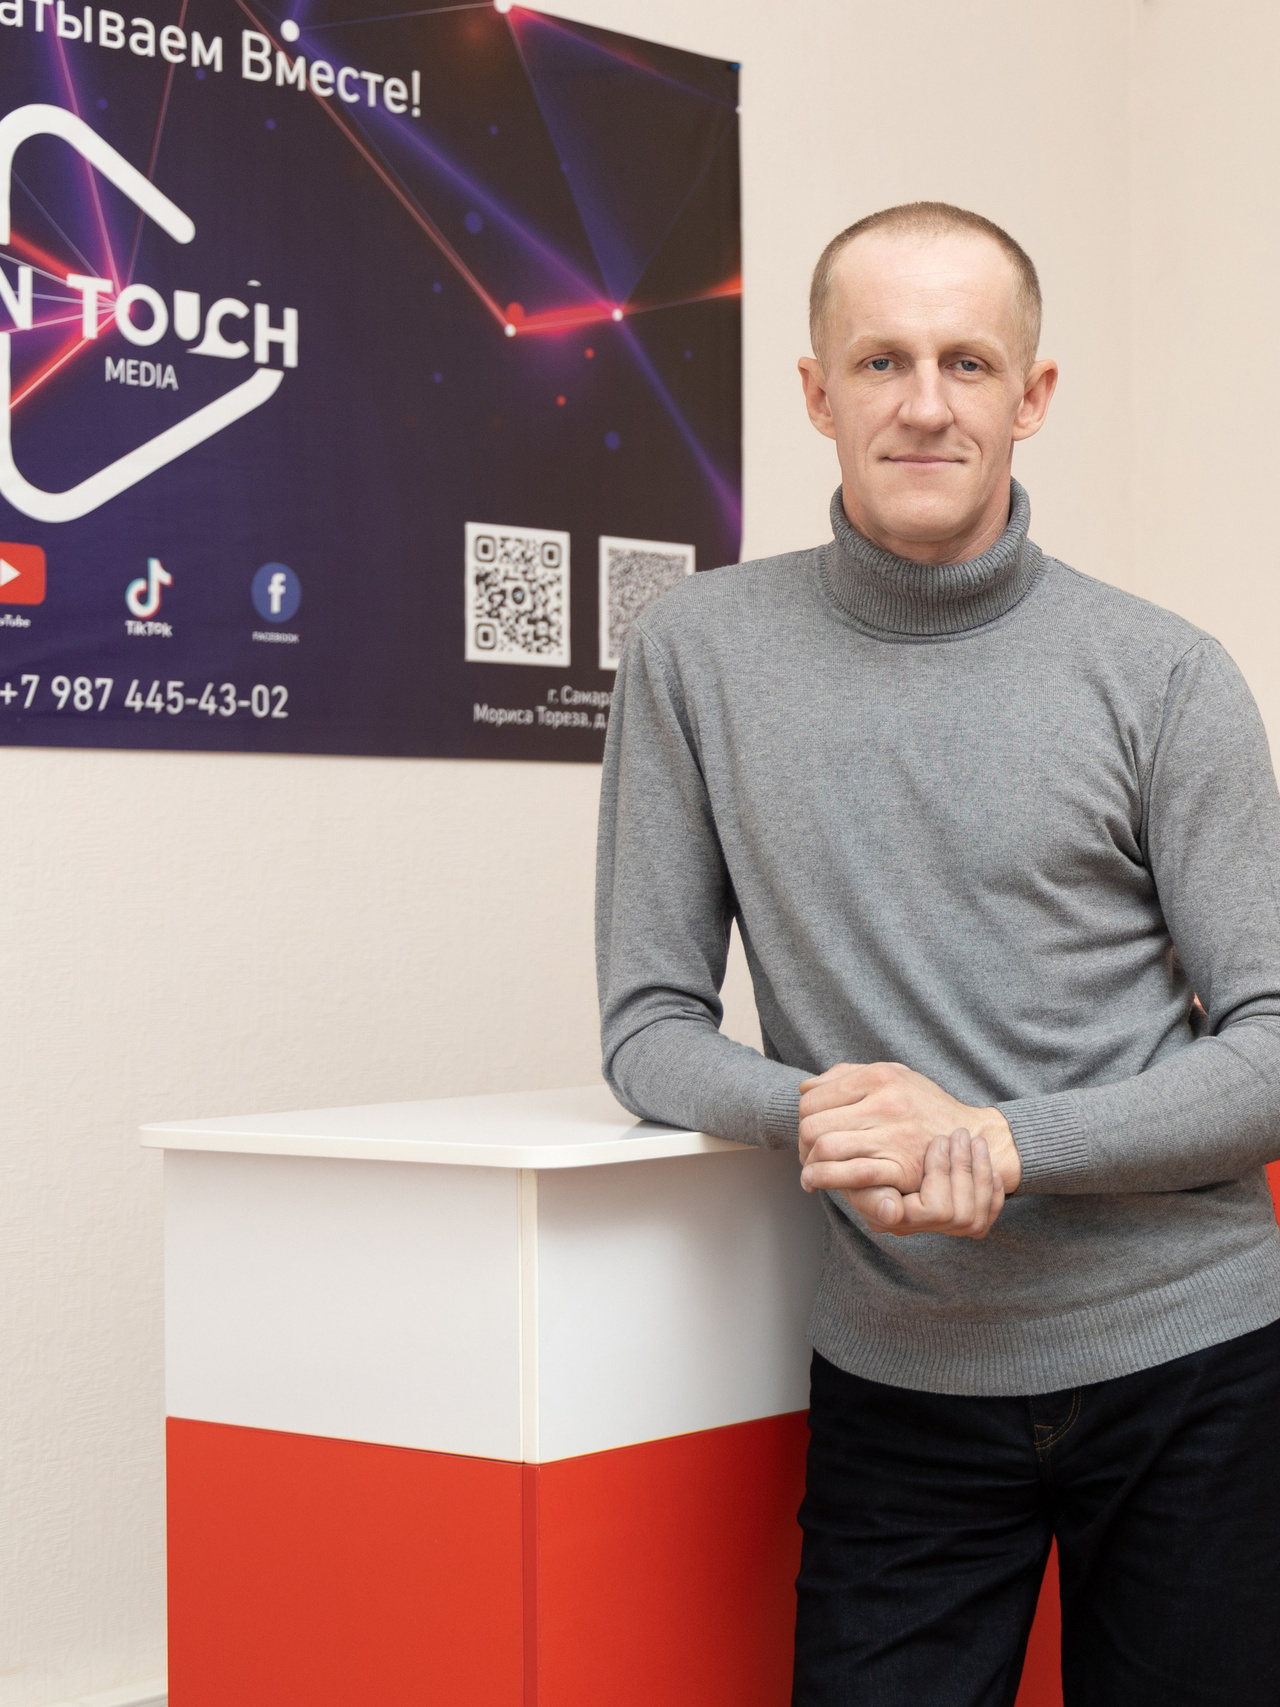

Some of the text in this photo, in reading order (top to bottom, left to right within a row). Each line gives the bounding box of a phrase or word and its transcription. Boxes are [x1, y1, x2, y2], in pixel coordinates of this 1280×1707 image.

[242, 29, 421, 118] Вместе!
[67, 273, 298, 368] TOUCH
[105, 356, 179, 391] MEDIA
[125, 620, 173, 638] TikTok
[252, 631, 300, 644] FACEBOOK
[0, 674, 289, 719] +7 987 445-43-02
[547, 688, 559, 704] г.
[473, 702, 534, 728] Мориса
[535, 705, 592, 731] Тореза,
